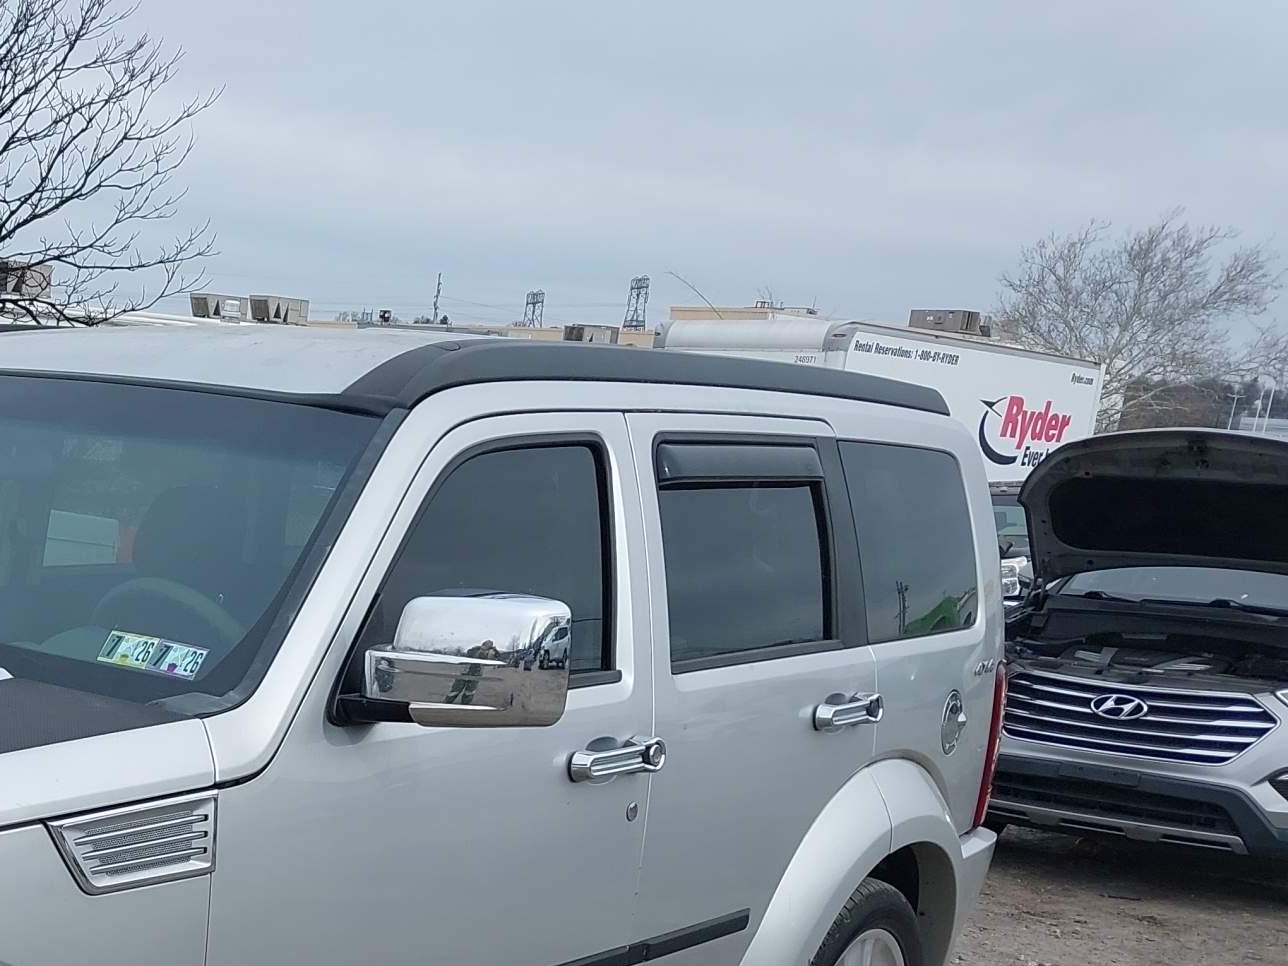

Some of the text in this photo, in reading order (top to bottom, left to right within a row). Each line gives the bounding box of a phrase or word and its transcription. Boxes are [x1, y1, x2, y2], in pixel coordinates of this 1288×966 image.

[853, 340, 874, 353] Rental
[874, 342, 913, 359] Reservations:
[1000, 396, 1072, 449] Ryder
[106, 635, 155, 663] 7 26
[152, 644, 204, 674] 7 26
